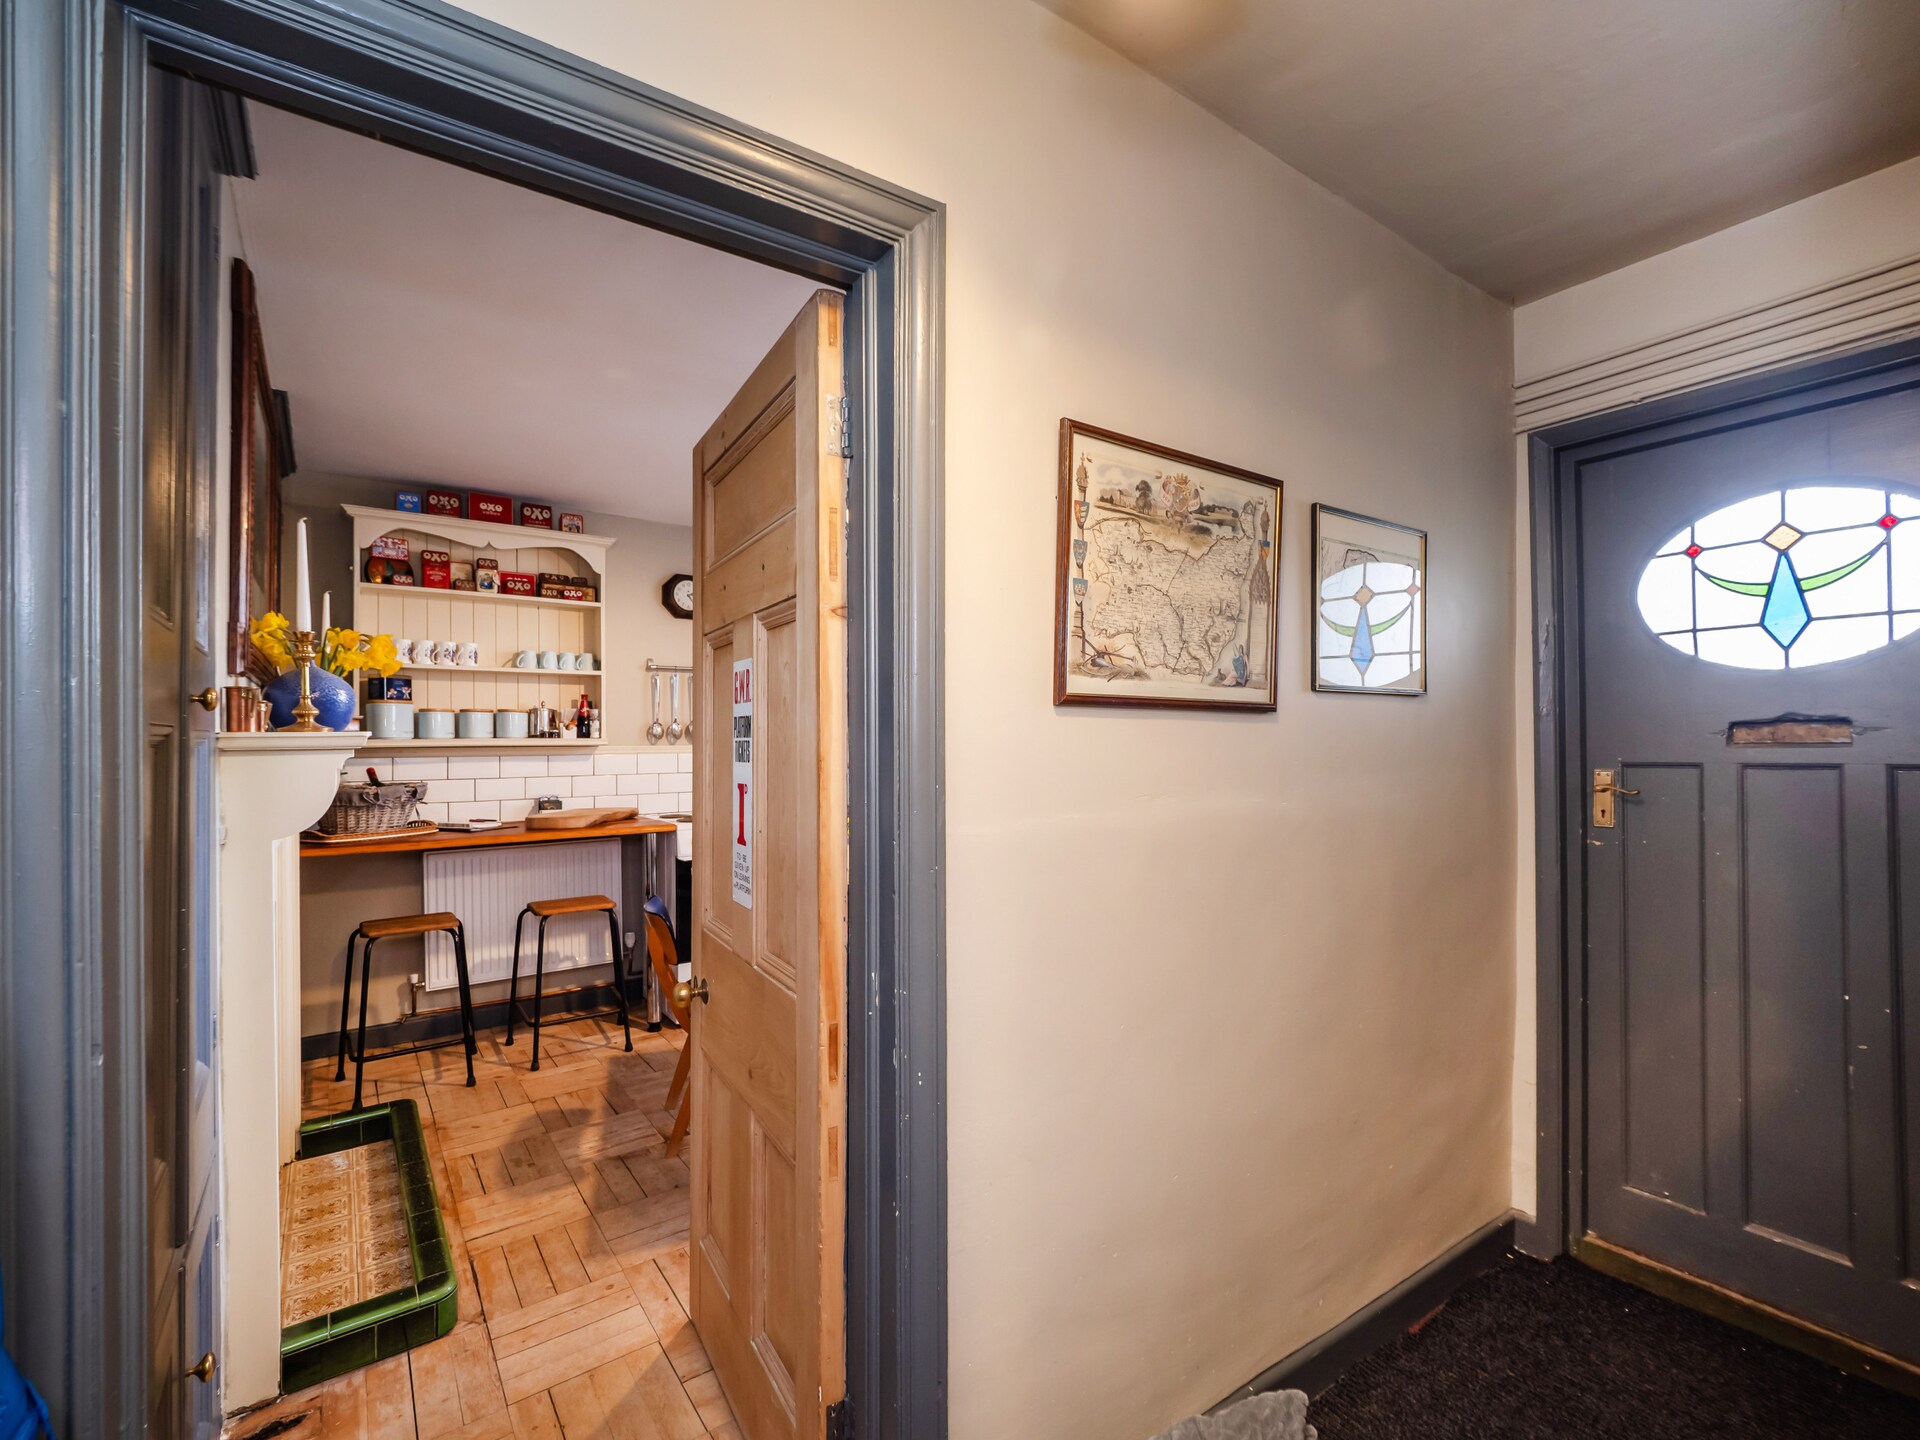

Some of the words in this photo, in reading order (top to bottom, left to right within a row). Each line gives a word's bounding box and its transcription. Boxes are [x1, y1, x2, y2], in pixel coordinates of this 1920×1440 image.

[399, 494, 419, 503] OXO
[429, 494, 460, 509] OXO
[479, 502, 503, 512] OXO
[523, 506, 551, 521] OXO
[423, 551, 449, 563] OXO
[478, 559, 498, 567] OXO
[393, 574, 413, 583] OXO
[507, 581, 531, 591] OXO
[541, 588, 558, 596] OXO
